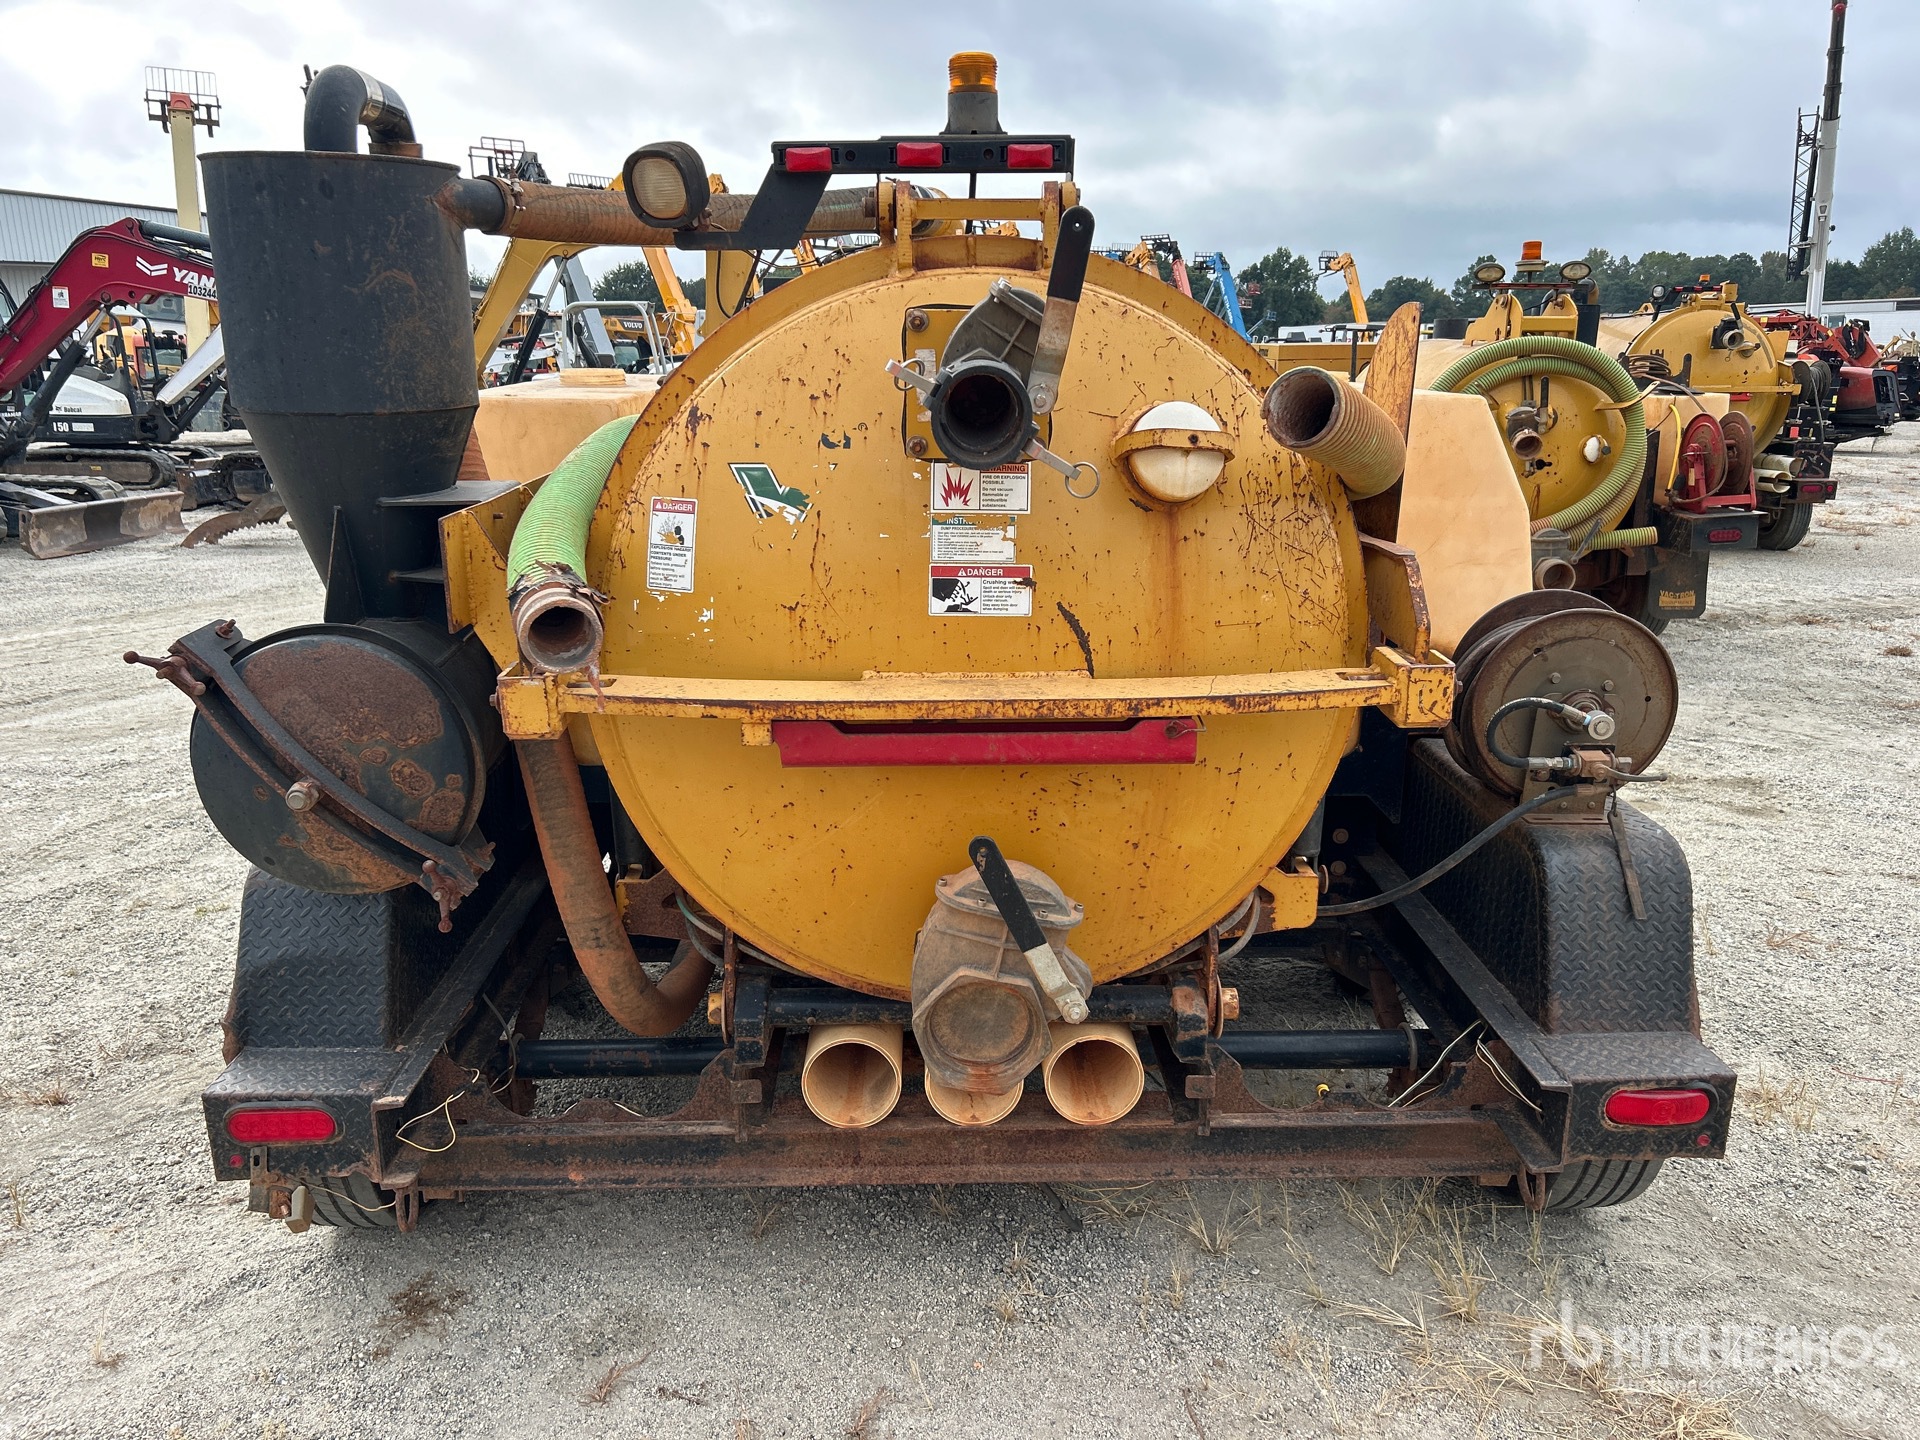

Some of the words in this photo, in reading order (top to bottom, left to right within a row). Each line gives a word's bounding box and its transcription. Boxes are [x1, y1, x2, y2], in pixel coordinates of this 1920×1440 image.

[173, 266, 217, 288] YAN
[188, 284, 218, 299] 103244
[662, 502, 692, 511] DANGER
